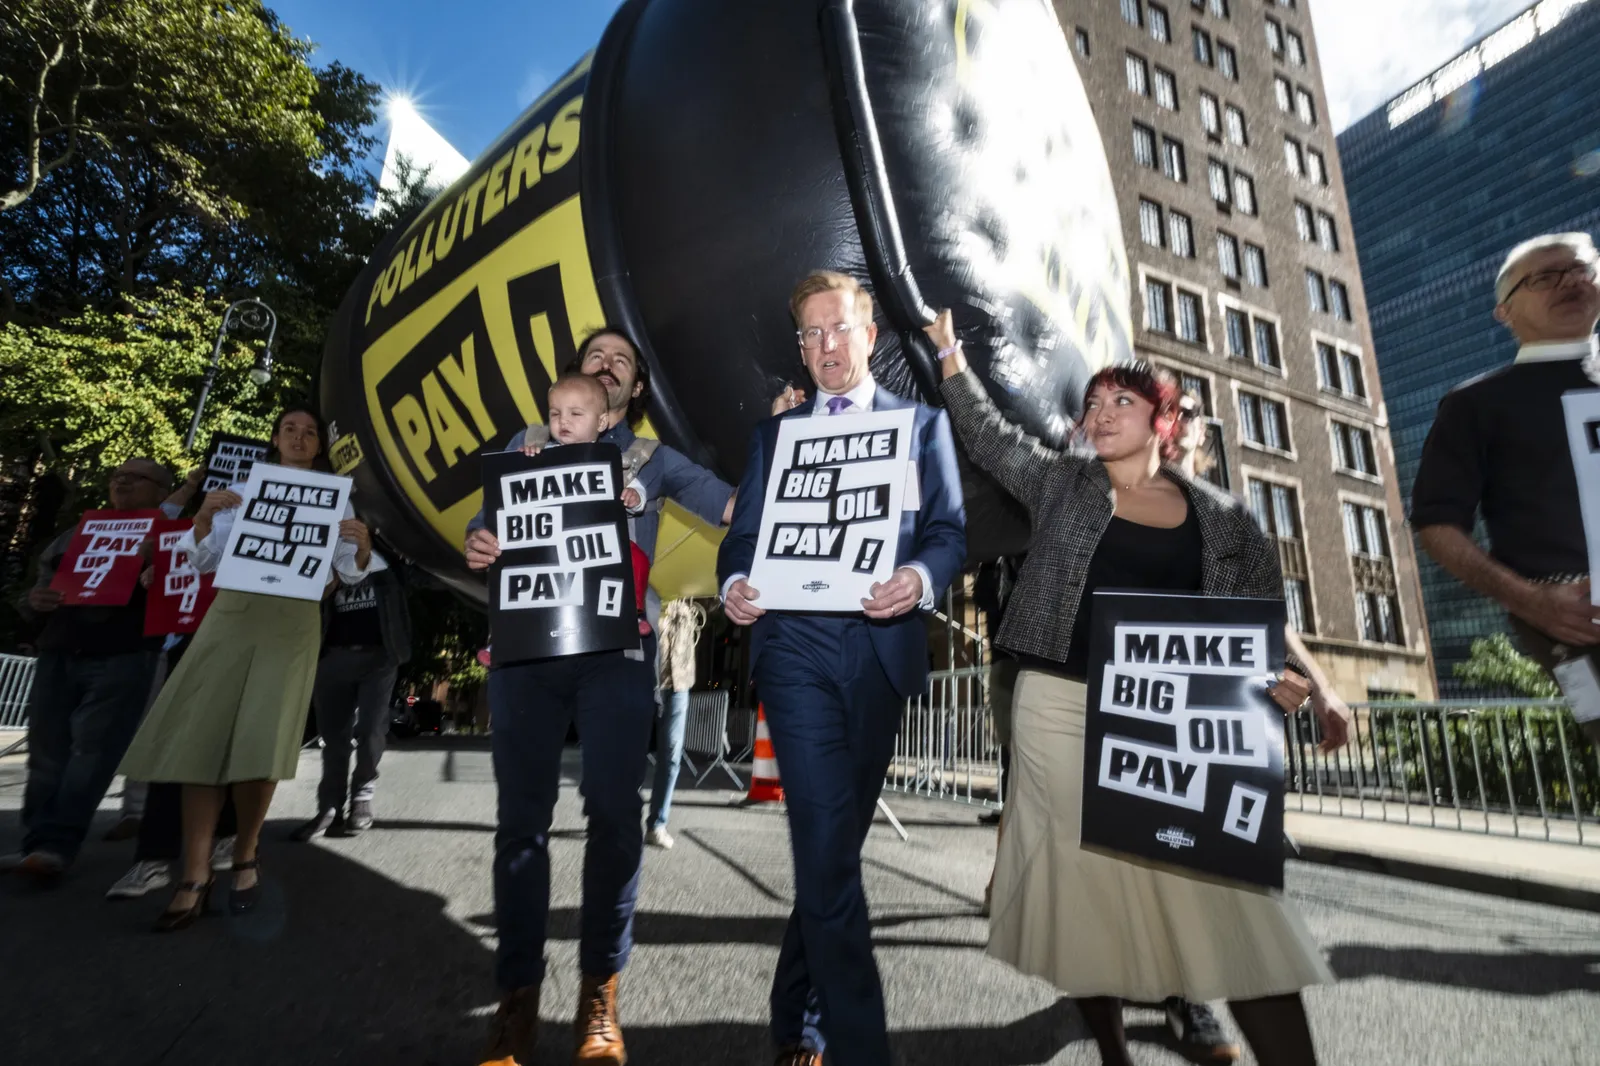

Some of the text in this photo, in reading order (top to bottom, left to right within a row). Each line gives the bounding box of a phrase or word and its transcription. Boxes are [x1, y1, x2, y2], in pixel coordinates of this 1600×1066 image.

[365, 95, 583, 327] POLLUTERS
[391, 331, 498, 484] PAY
[797, 430, 890, 466] MAKE
[213, 456, 236, 470] BIG
[206, 479, 231, 490] PA
[263, 483, 335, 507] MAKE
[508, 469, 607, 504] MAKE
[782, 471, 833, 499] BIG
[250, 501, 290, 525] BIG
[835, 488, 882, 522] OIL
[87, 521, 149, 531] POLLUTERS
[289, 524, 323, 544] OIL
[506, 512, 554, 543] BIG
[93, 537, 140, 552] PAY
[238, 536, 292, 562] PAY
[566, 532, 612, 563] OIL
[772, 524, 842, 557] PAY
[80, 556, 109, 569] UP
[304, 559, 317, 576] !
[861, 542, 878, 570] !
[91, 573, 101, 585] !
[169, 575, 195, 591] UP
[508, 571, 576, 603] PAY
[184, 595, 192, 609] !
[606, 585, 618, 611] !
[1123, 633, 1255, 668] MAKE
[1112, 673, 1175, 715] BIG
[1188, 717, 1255, 757] OIL
[1108, 747, 1197, 798] PAY
[1235, 795, 1256, 832] !
